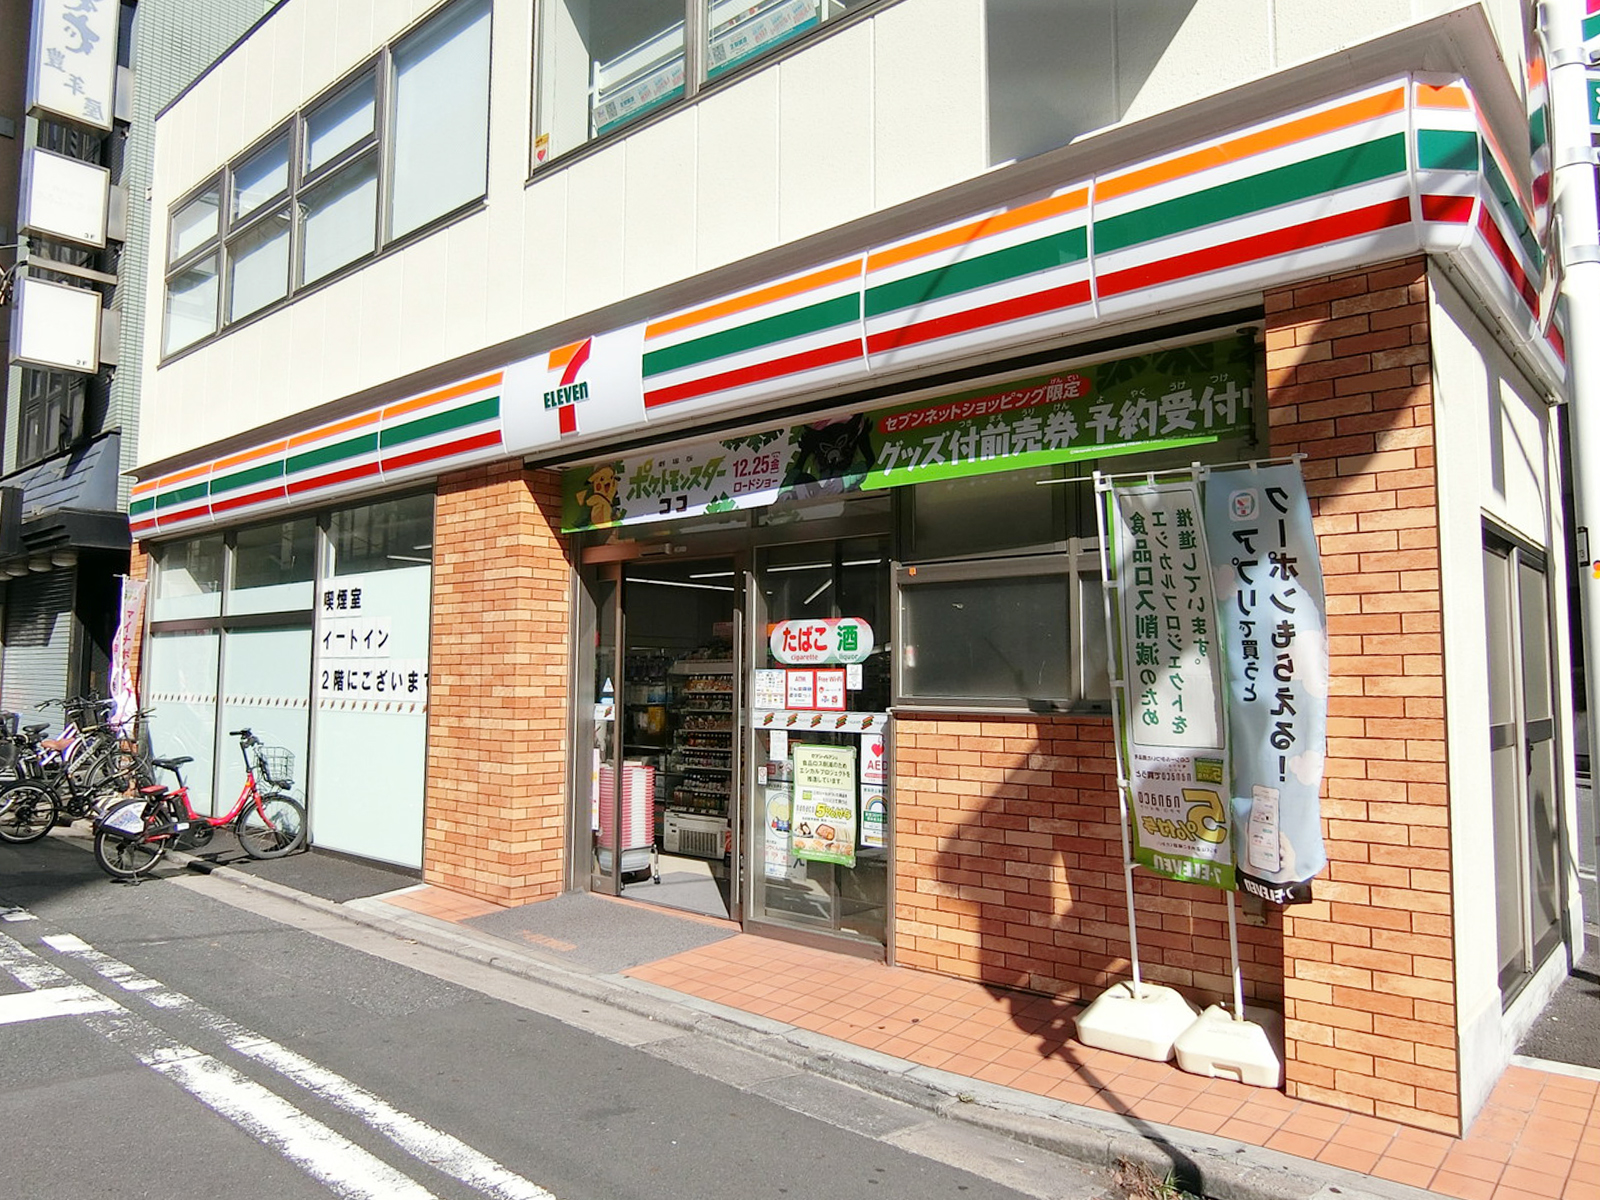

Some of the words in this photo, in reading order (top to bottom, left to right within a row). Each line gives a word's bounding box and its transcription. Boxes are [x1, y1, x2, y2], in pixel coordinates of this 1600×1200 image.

[547, 337, 592, 434] 7
[885, 381, 1081, 432] セブンネットショッピング限定
[877, 410, 1079, 477] グッズ付前売券
[1084, 381, 1254, 444] 予約受付
[626, 455, 728, 502] ポケットモンスター
[733, 478, 778, 493] ロードショー
[659, 494, 688, 515] ココ
[323, 588, 362, 611] 喫煙室
[322, 628, 389, 650] イートイン
[782, 626, 828, 652] たばこ
[837, 625, 859, 652] 酒
